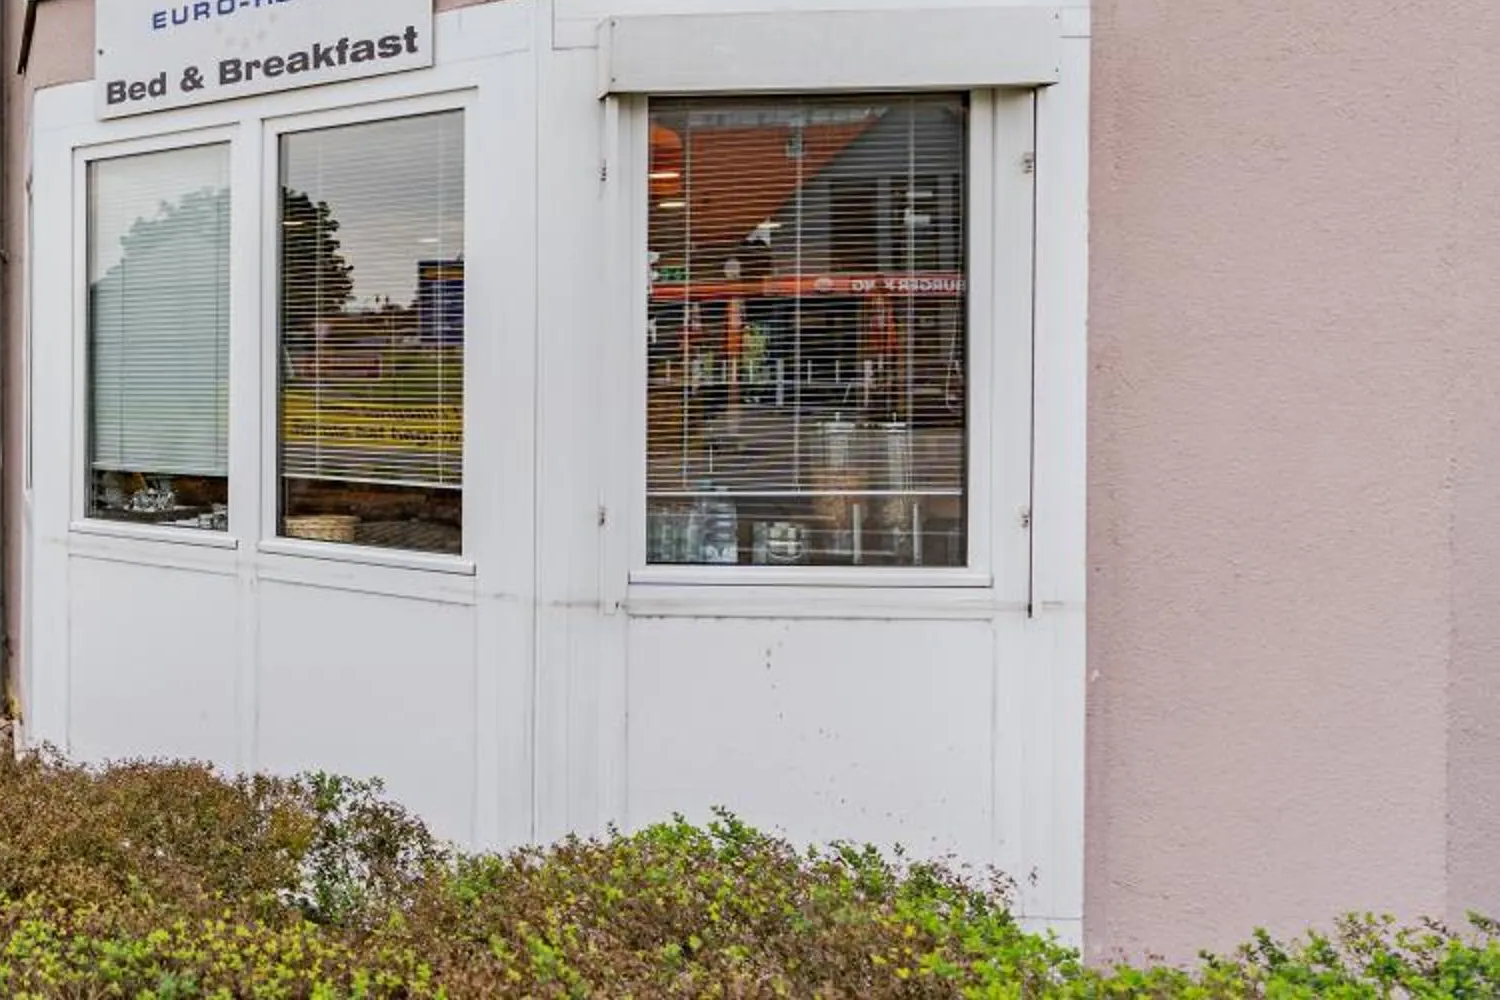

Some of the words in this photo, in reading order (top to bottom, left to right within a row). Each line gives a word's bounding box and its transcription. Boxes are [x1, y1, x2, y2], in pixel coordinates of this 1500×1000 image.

[106, 71, 167, 105] Bed
[179, 65, 205, 93] &
[218, 24, 419, 86] Breakfast
